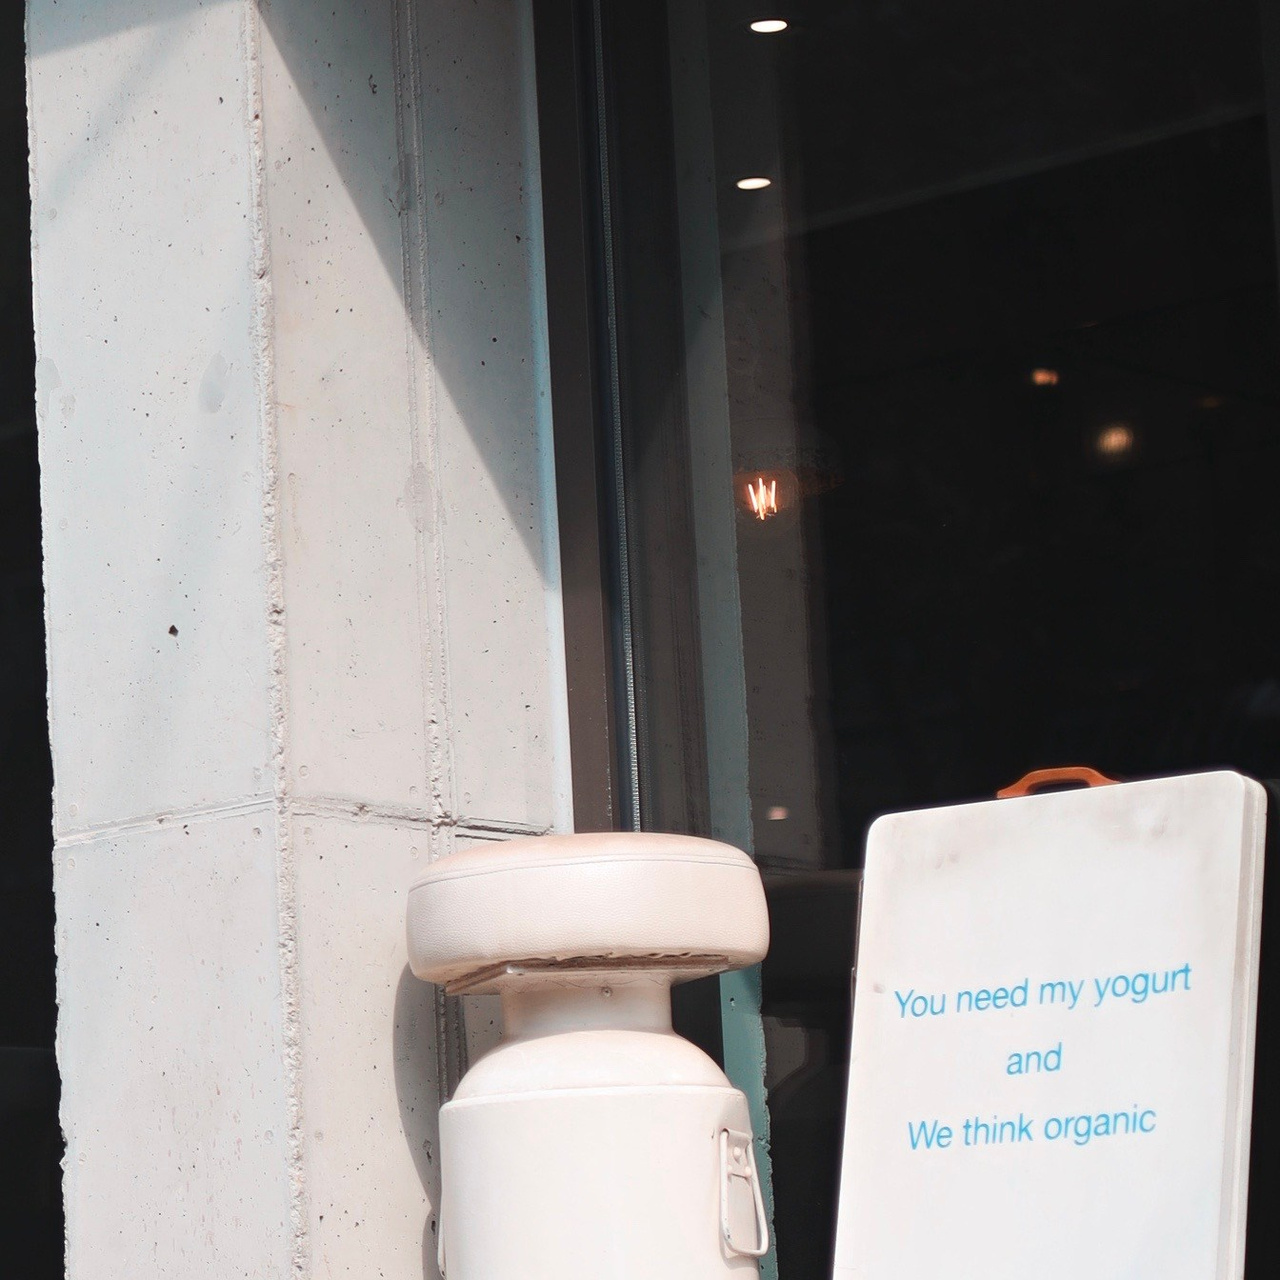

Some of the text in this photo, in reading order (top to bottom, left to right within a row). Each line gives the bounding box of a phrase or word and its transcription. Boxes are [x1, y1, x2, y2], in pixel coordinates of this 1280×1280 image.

[894, 962, 1192, 1018] You need my yogurt
[1006, 1041, 1062, 1075] and
[908, 1103, 1157, 1150] We think organic
